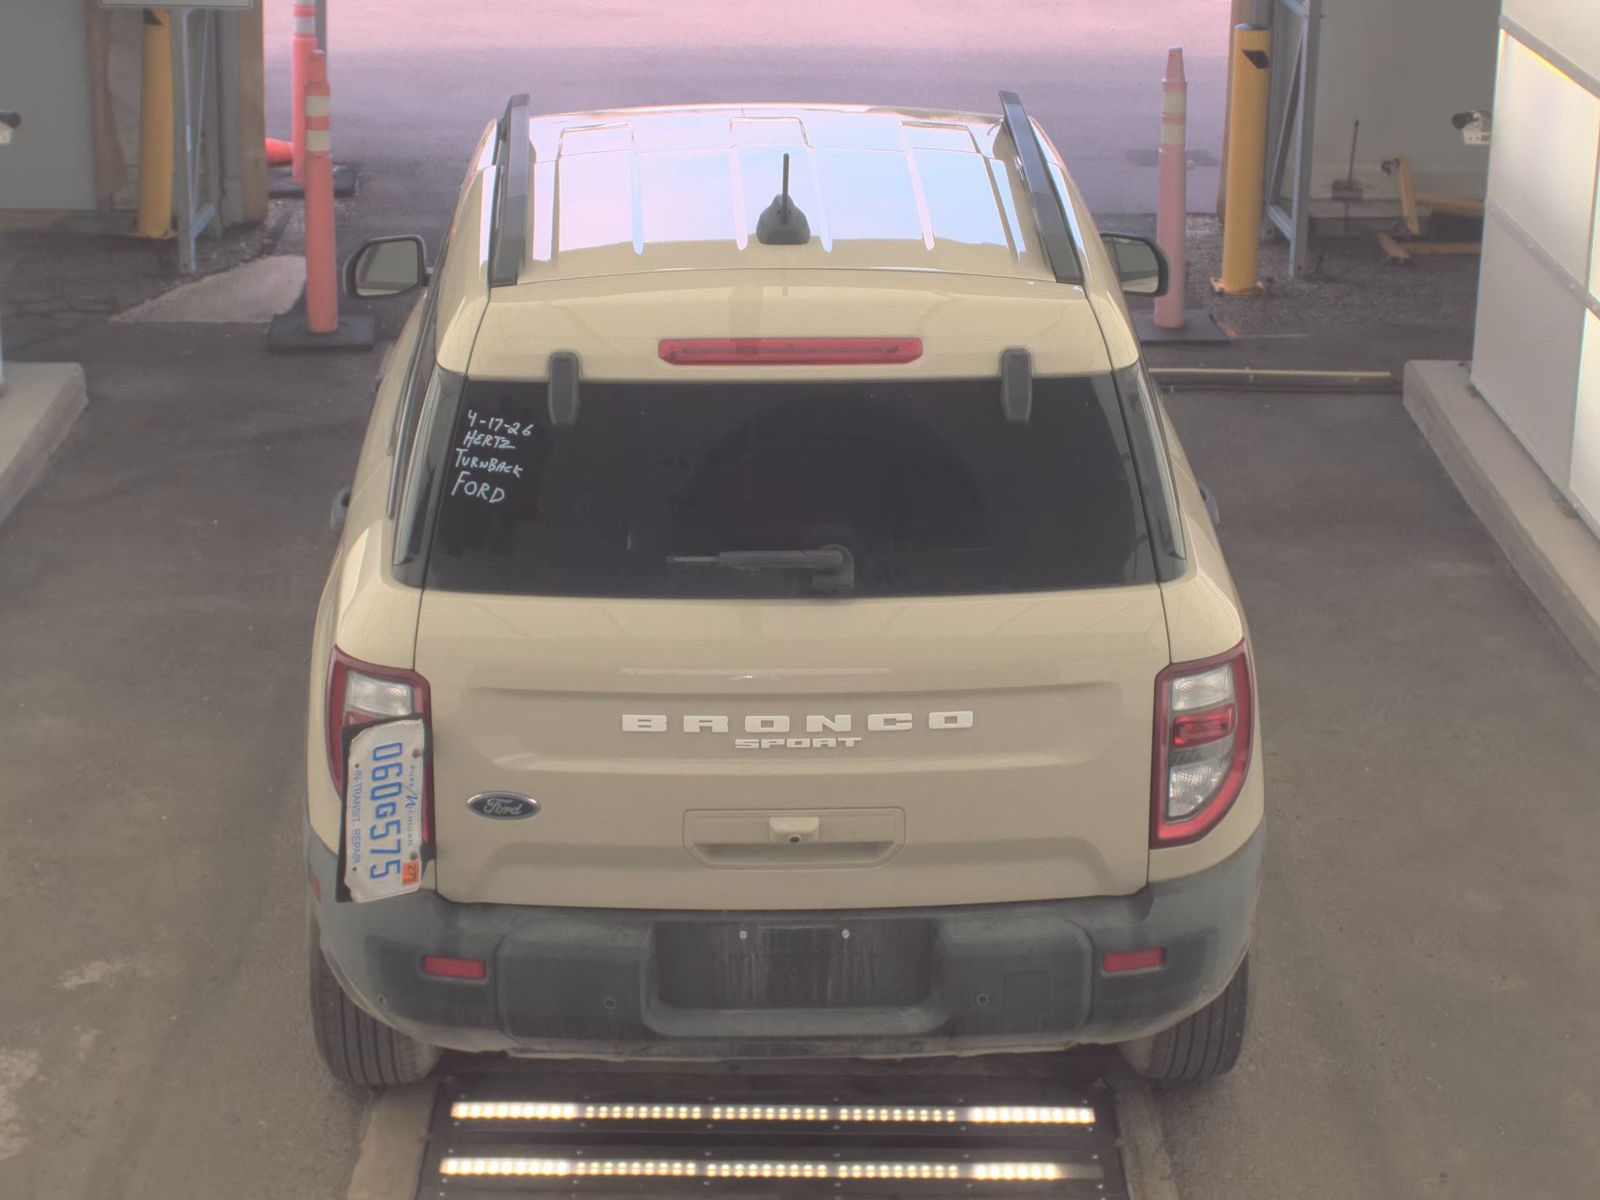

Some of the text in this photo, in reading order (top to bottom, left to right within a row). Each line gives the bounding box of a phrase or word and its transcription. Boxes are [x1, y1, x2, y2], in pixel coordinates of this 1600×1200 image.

[468, 409, 534, 436] 4-17-26
[463, 429, 516, 449] HERTZ
[451, 470, 506, 503] FORD
[621, 710, 974, 733] BRONCO
[734, 737, 862, 749] SPORT
[351, 769, 362, 865] IN-TRANSIT REPAIR
[368, 741, 404, 880] 060G575
[483, 798, 523, 816] Ford
